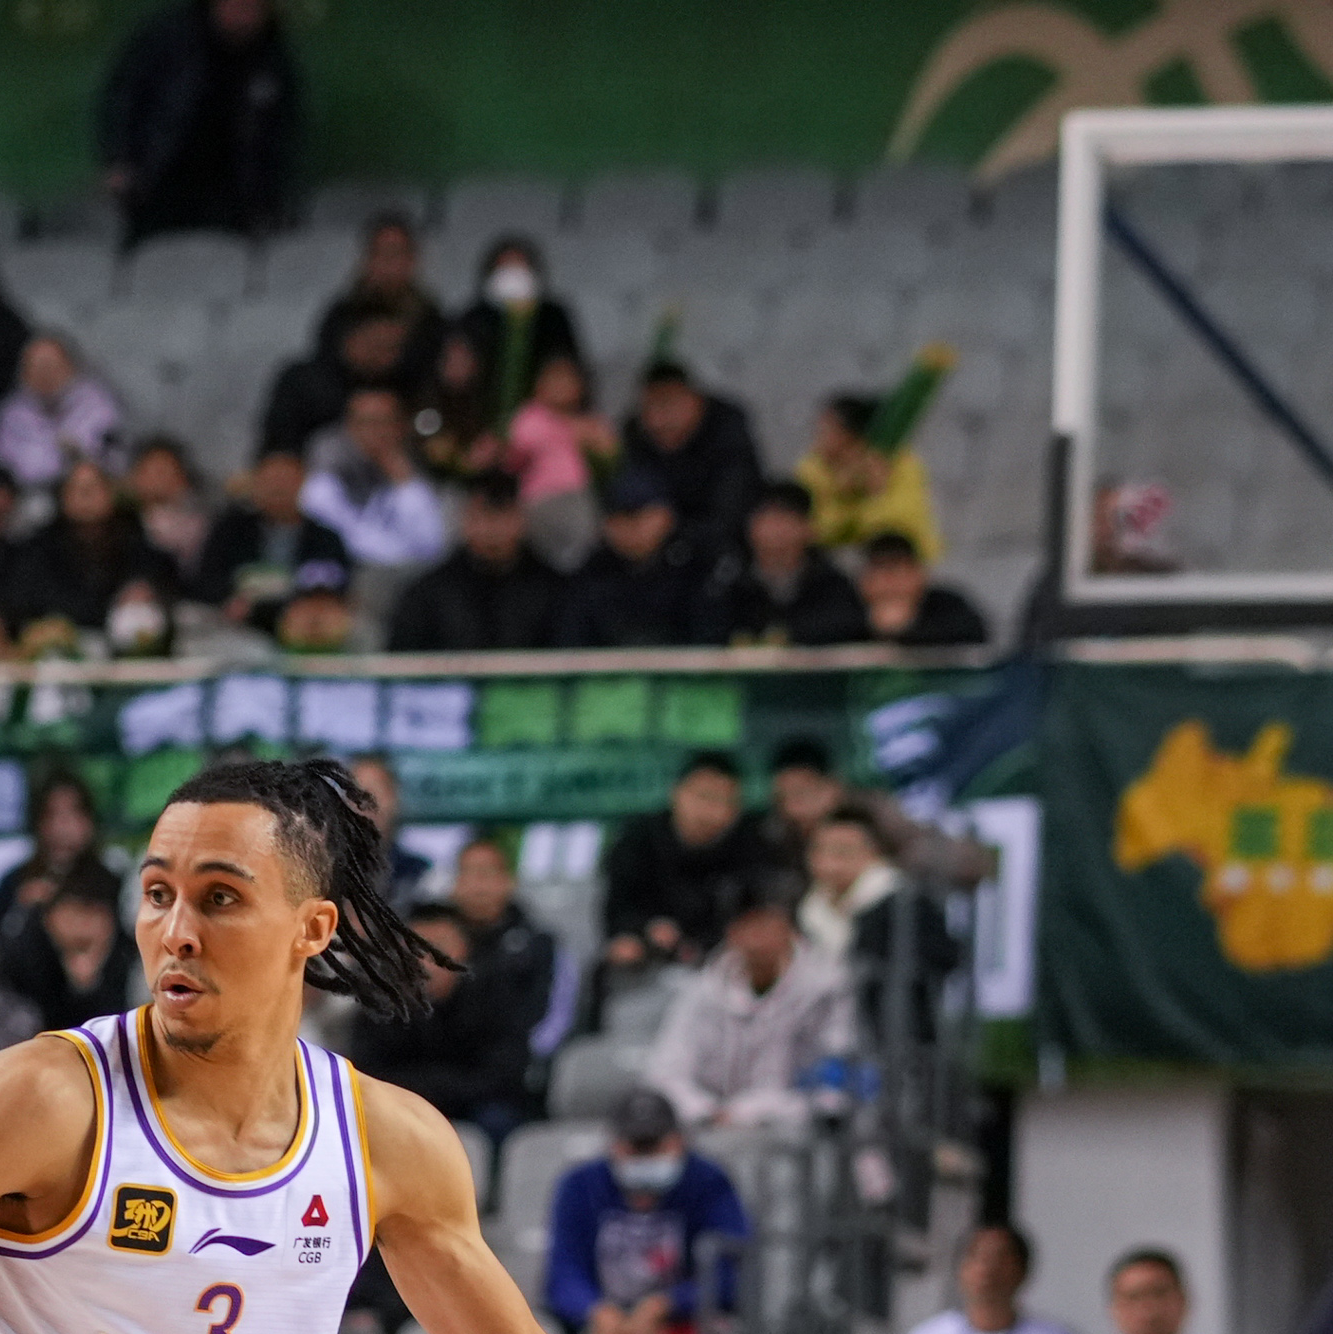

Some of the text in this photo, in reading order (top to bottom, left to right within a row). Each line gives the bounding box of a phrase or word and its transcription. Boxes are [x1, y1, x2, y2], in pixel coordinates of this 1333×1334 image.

[293, 1236, 332, 1249] 广发银行
[298, 1251, 322, 1264] CGB
